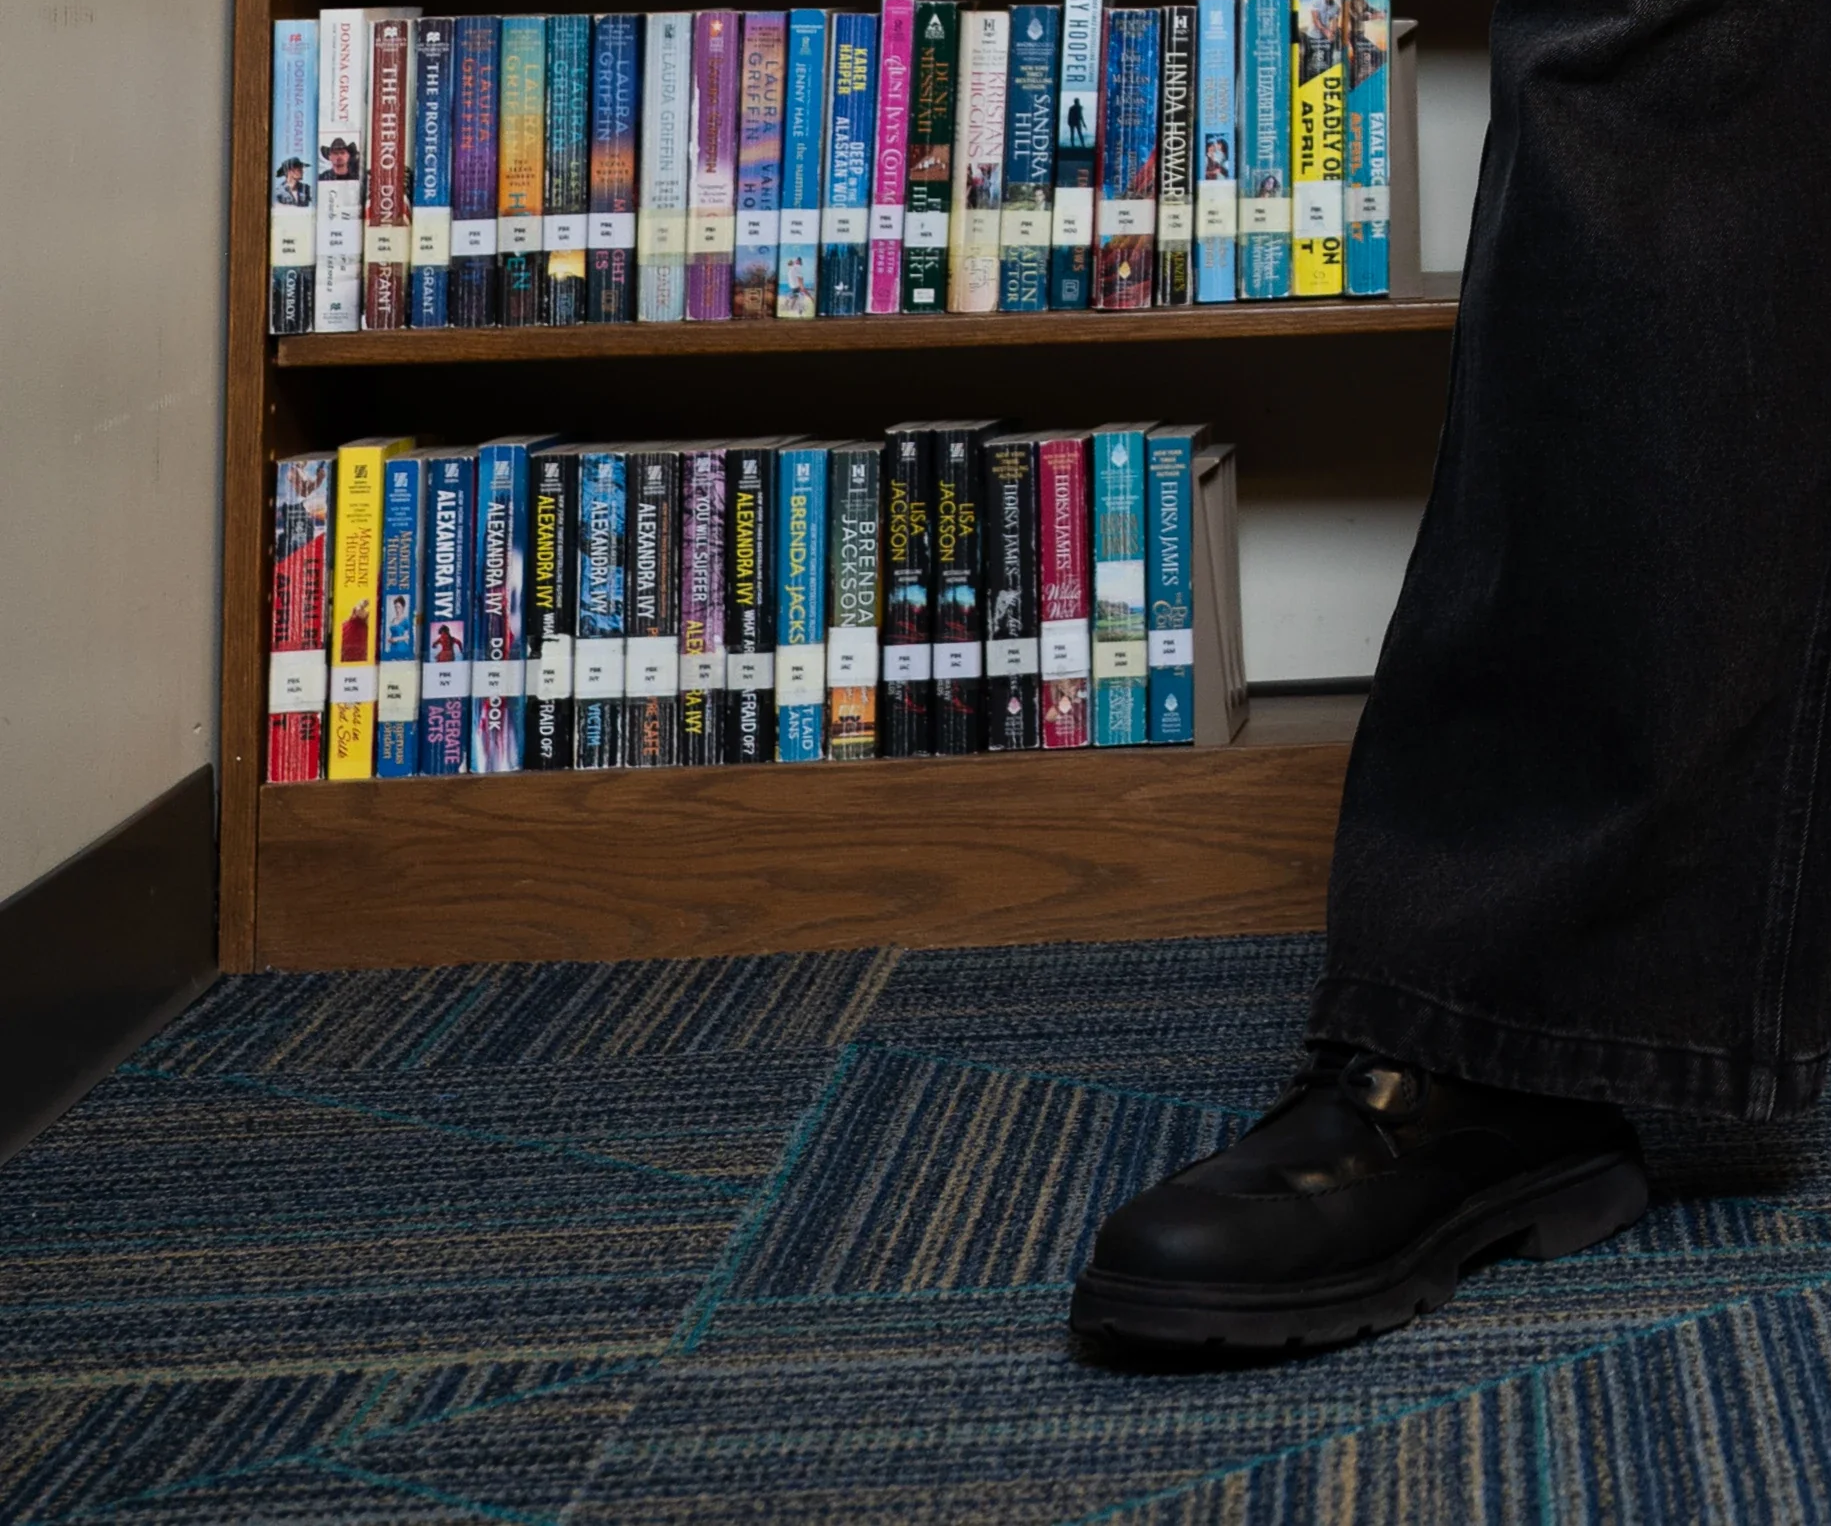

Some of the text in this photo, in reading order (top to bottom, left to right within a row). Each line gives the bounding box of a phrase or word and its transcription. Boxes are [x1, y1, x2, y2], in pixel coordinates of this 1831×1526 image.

[836, 44, 853, 94] HARPER
[853, 48, 868, 90] KAREN
[1065, 20, 1088, 82] HOOPER
[1165, 51, 1187, 111] LINDA
[380, 66, 398, 168] THE HERO
[745, 51, 763, 140] GRIFFIN
[762, 60, 778, 132] LAURA
[792, 62, 808, 136] JENNY HALE
[917, 47, 935, 132] MESSIAH
[933, 61, 950, 118] DUNE
[1321, 75, 1342, 148] DEADLY
[424, 62, 442, 198] THE PROTECTOR
[834, 116, 849, 176] ALASKAN
[849, 142, 865, 174] DEEP
[1014, 111, 1031, 159] HILL
[1031, 93, 1052, 176] SANDRA
[1301, 100, 1314, 174] APRIL
[434, 490, 456, 619] ALEXANDRA IVY
[692, 496, 709, 603] YOU WILL SUFFER
[938, 481, 956, 563] JACKSON
[957, 504, 974, 537] LISA
[1156, 482, 1181, 586] ELOISA JAMES
[356, 530, 372, 588] MADELINE
[485, 503, 506, 617] ALEXANDRA IVY
[839, 514, 857, 628] JACKSON
[857, 523, 874, 624] BRENDA
[428, 706, 445, 744] ACTS
[586, 704, 600, 746] VICTIM
[644, 722, 657, 755] SAFE
